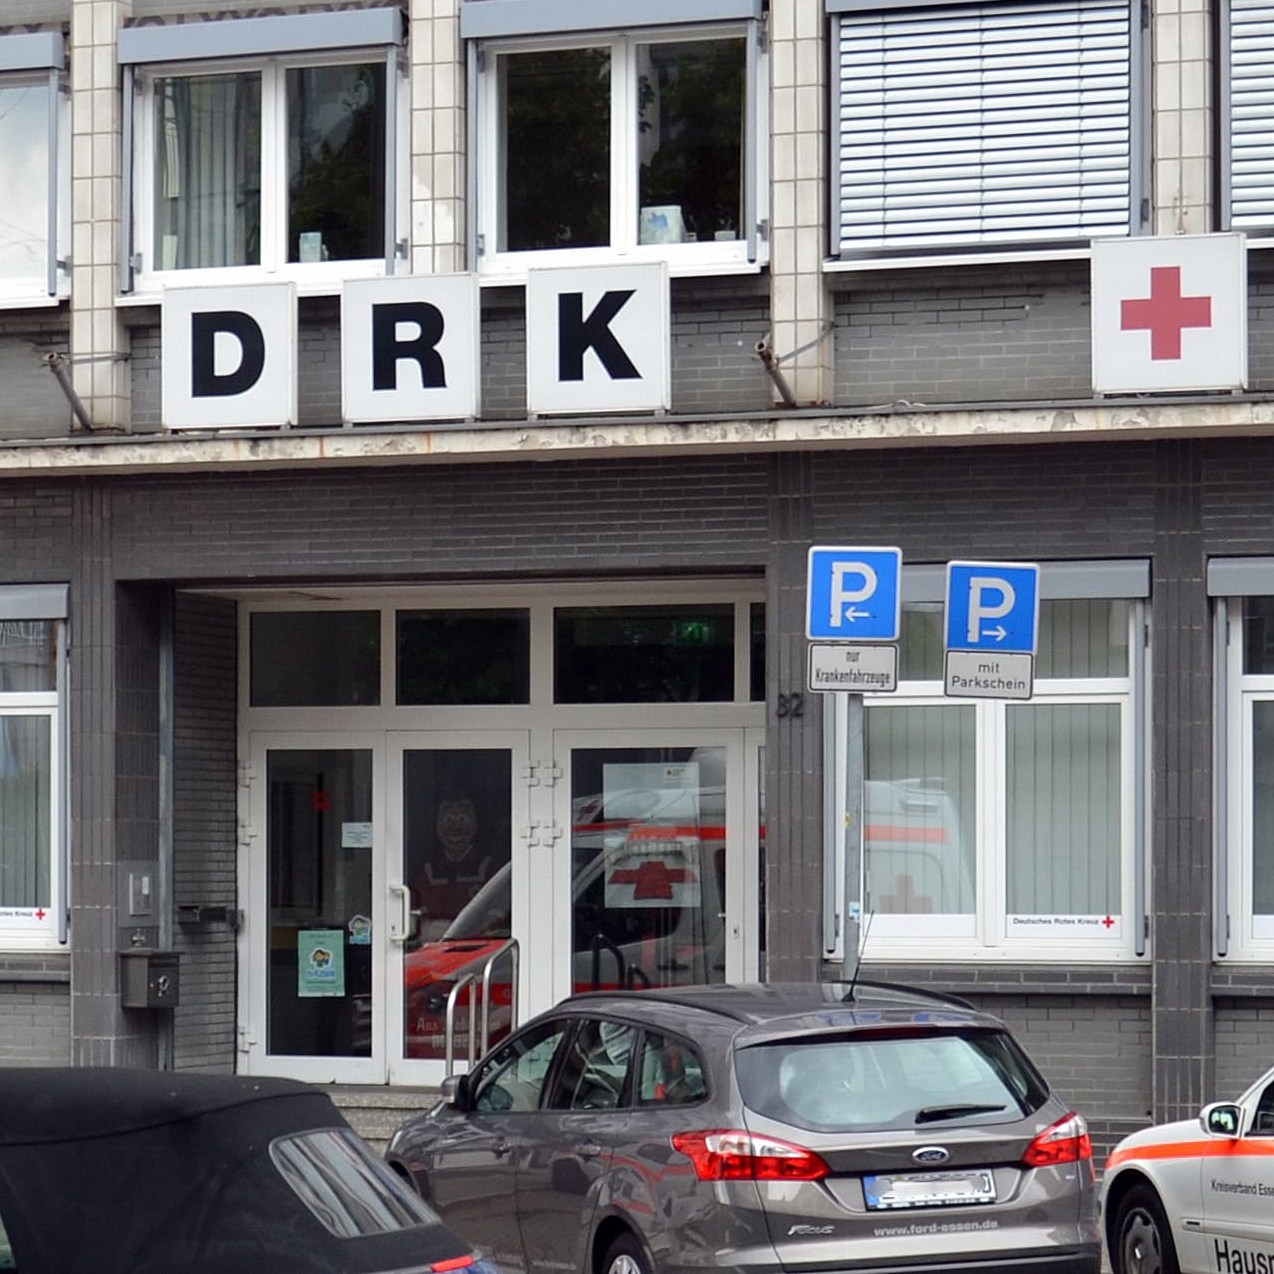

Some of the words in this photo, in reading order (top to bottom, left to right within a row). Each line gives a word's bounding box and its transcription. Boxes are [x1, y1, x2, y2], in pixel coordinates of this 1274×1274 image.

[191, 288, 642, 398] DRK
[830, 562, 877, 627] P
[967, 577, 1016, 643] P
[845, 651, 861, 663] nur
[978, 662, 1000, 674] mit
[815, 668, 891, 688] Krankenfahrzeuge
[951, 676, 1026, 691] Parkschein
[1211, 1179, 1257, 1195] Kreisverband
[873, 1219, 999, 1238] www.ford-essen.de
